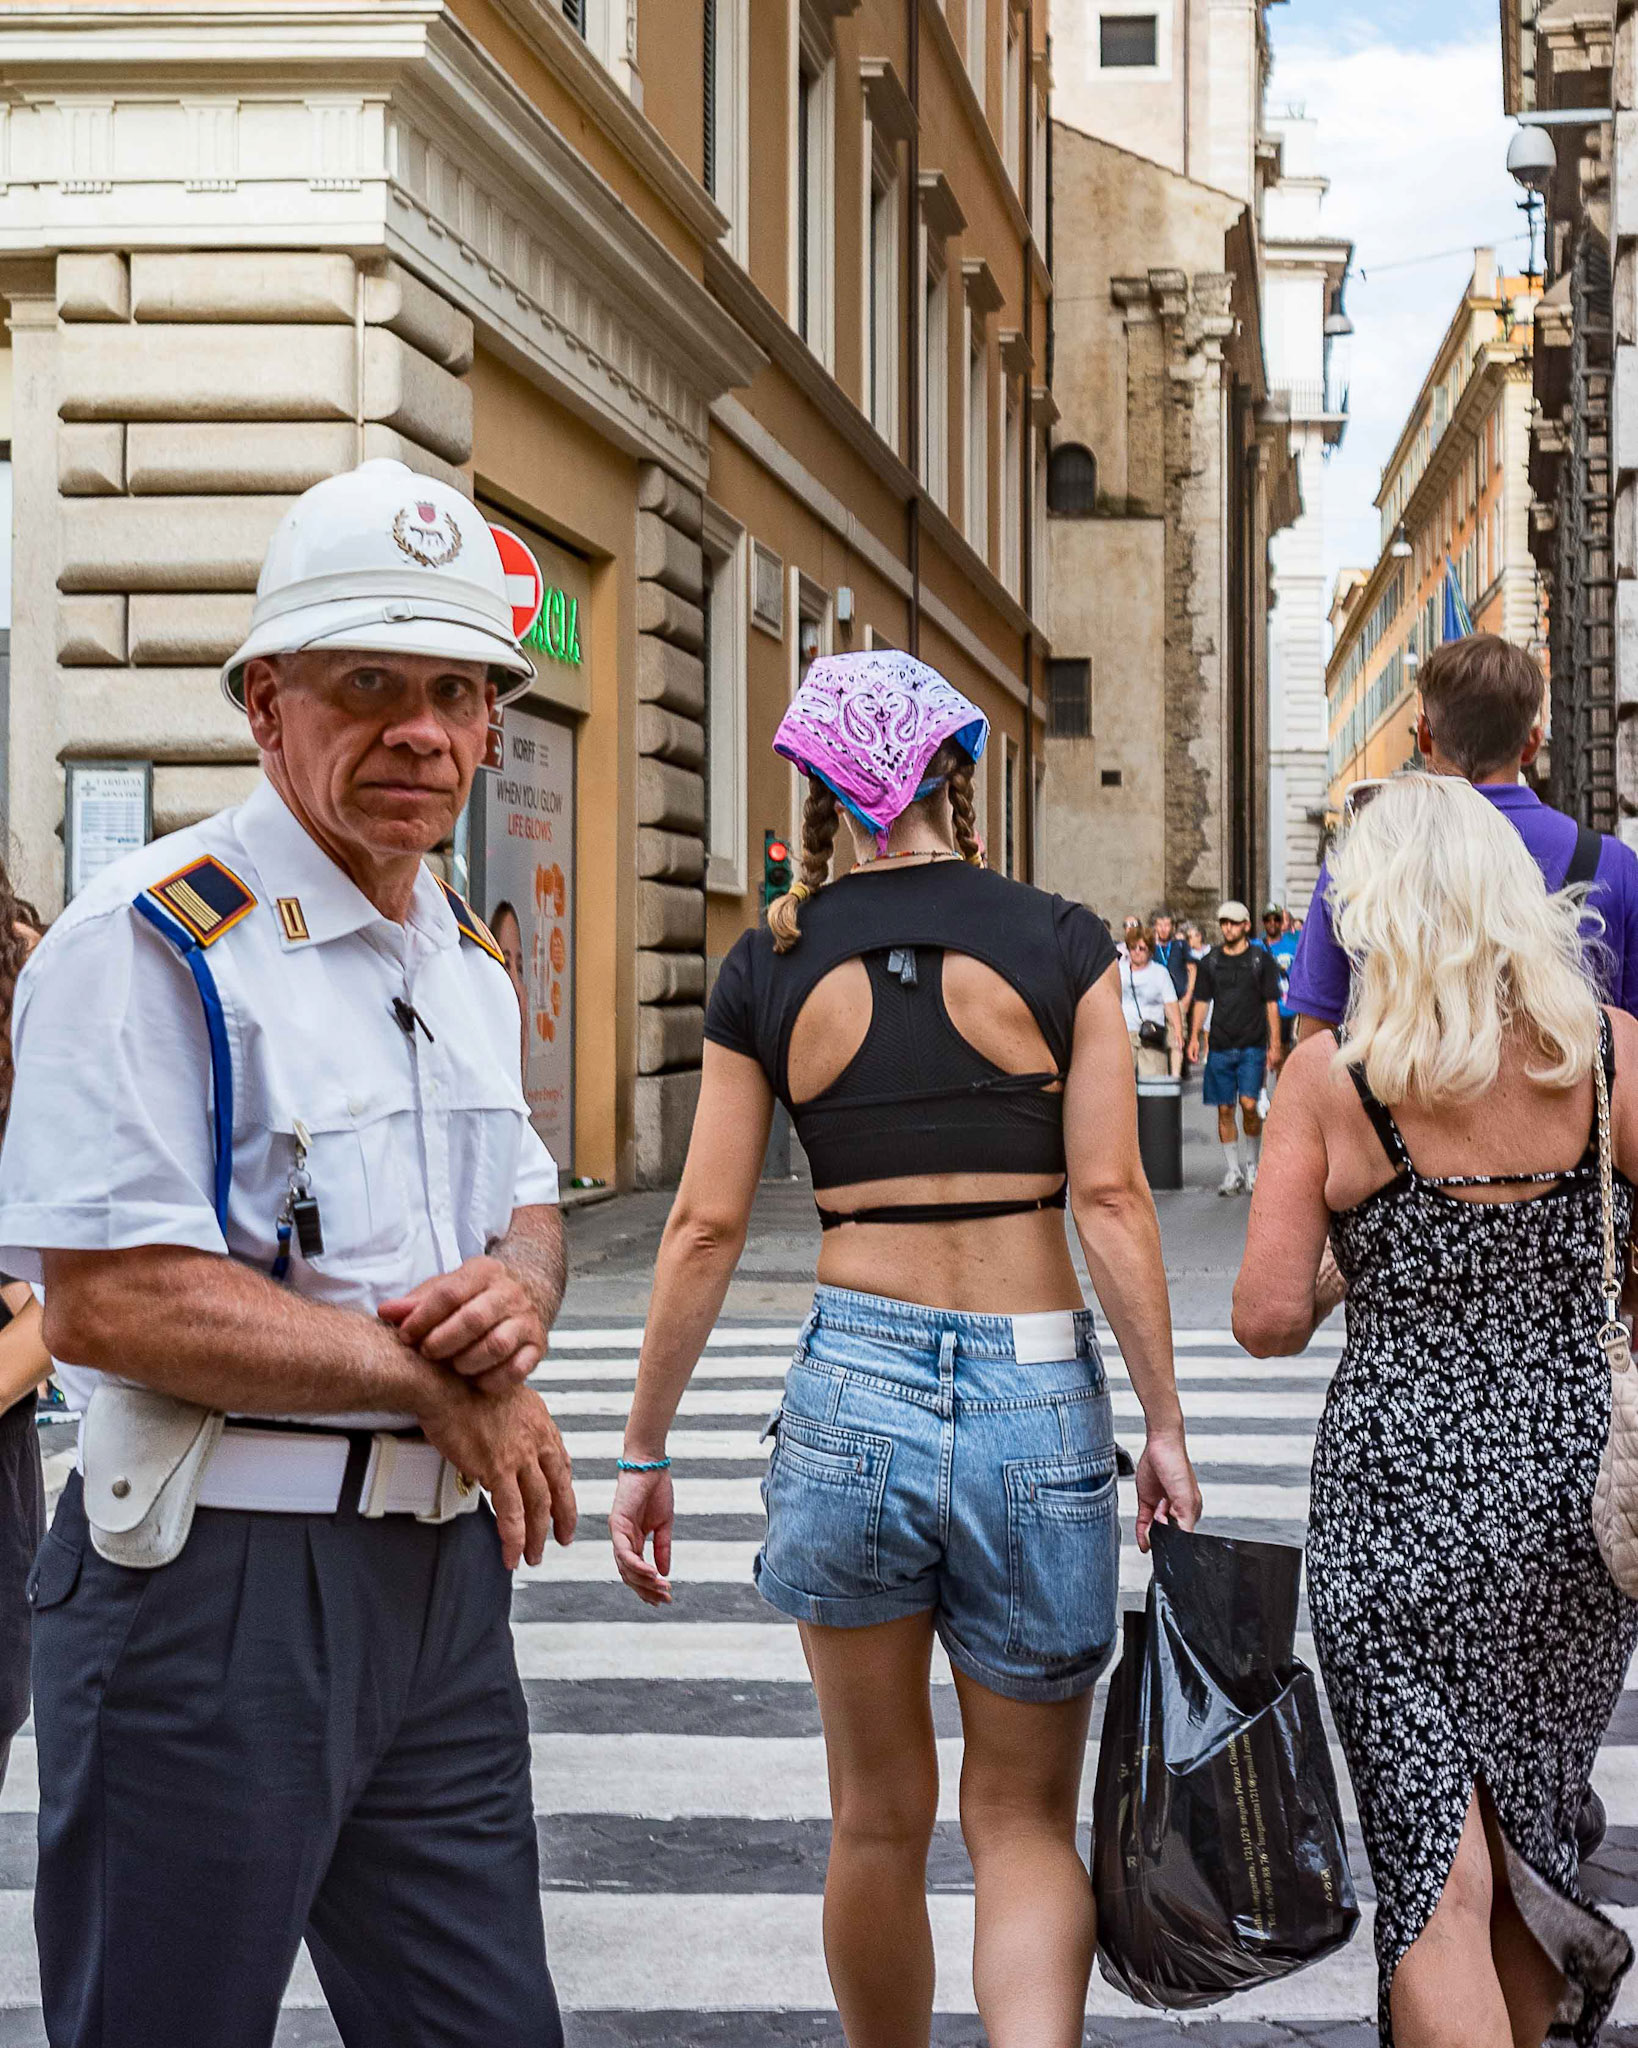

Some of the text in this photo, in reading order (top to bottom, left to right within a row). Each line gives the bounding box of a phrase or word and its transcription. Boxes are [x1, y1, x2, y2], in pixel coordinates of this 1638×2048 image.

[513, 735, 536, 763] KORFF
[497, 779, 563, 815] WHEN YOU GLOW
[508, 812, 554, 842] LIFE GLOWS
[1233, 1766, 1243, 1794] Piazza
